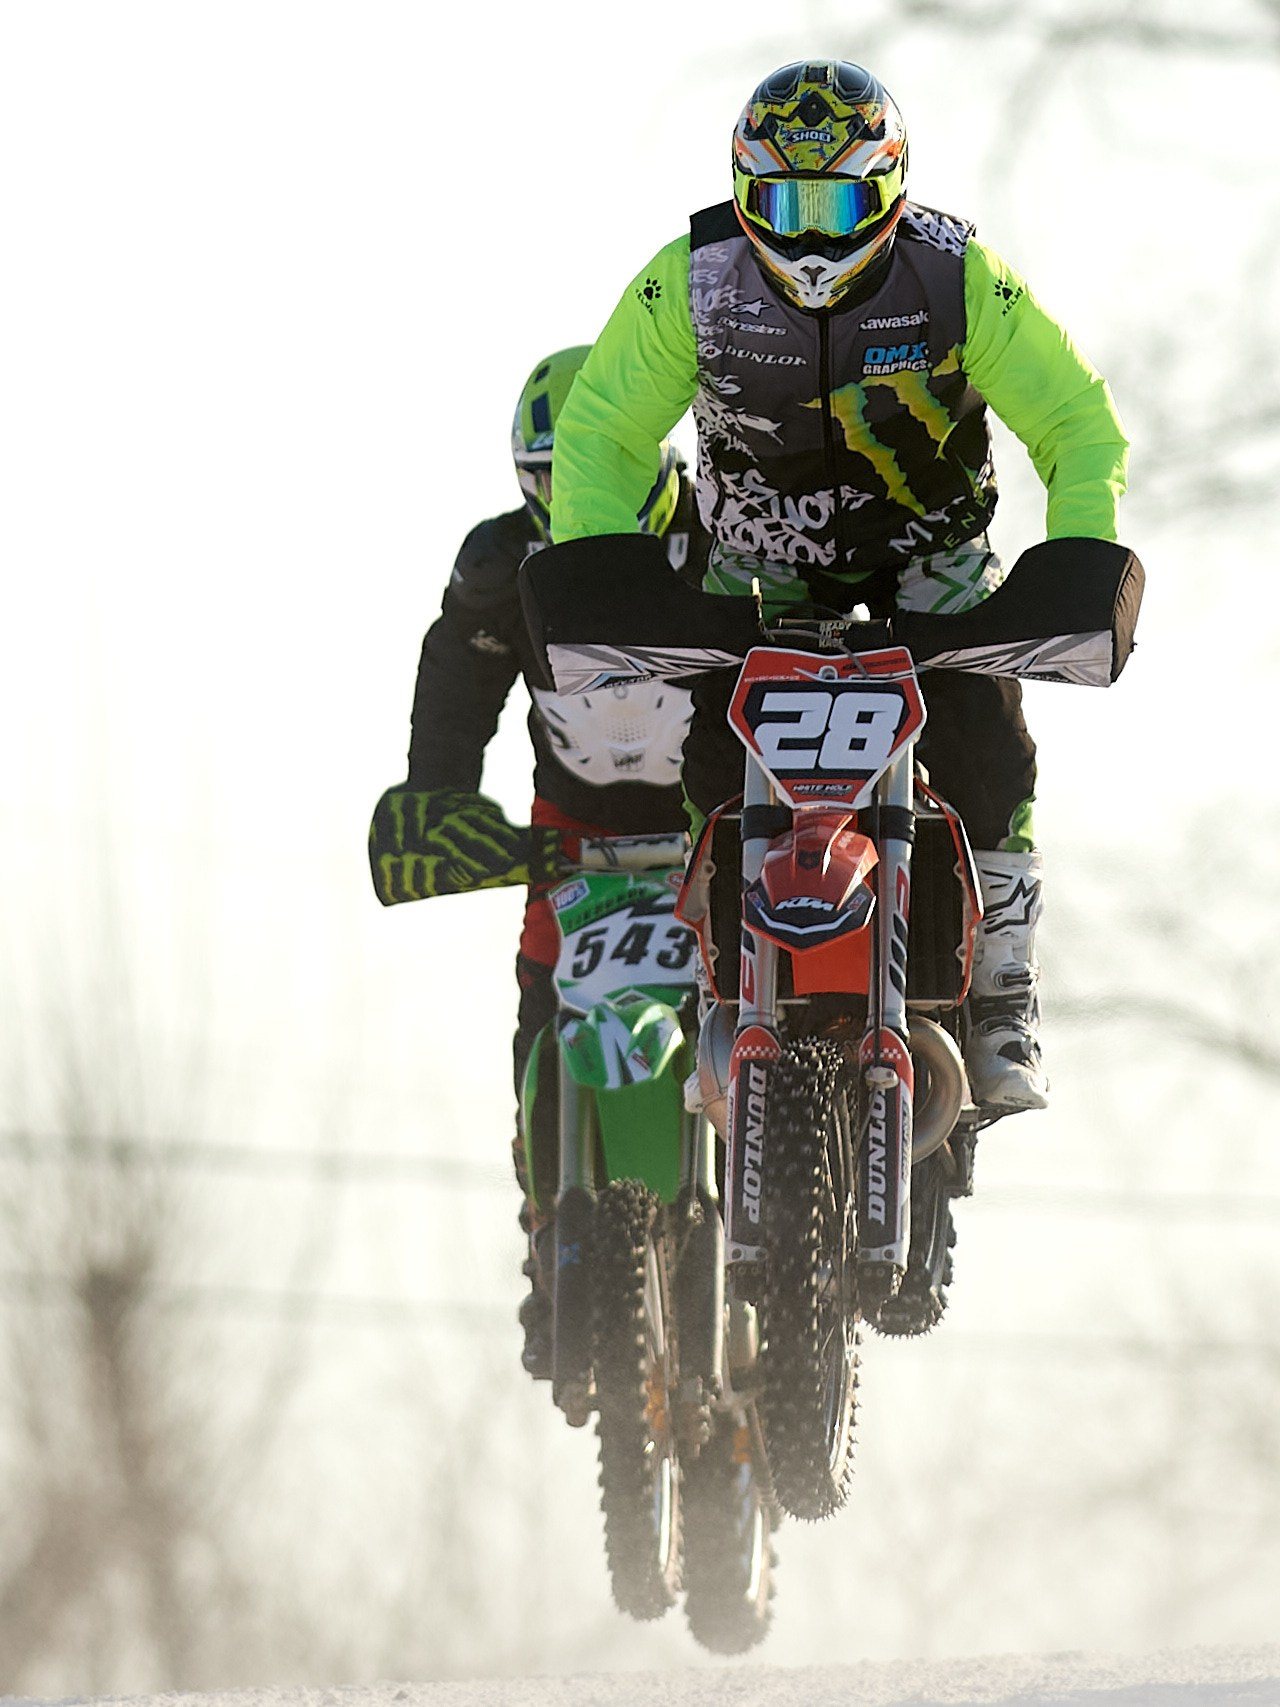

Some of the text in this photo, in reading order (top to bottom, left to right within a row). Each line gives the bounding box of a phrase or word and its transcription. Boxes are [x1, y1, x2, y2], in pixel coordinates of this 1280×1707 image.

[791, 130, 831, 143] SHOEI
[860, 310, 929, 329] awasak
[863, 360, 927, 375] GRAPHICS
[752, 692, 904, 770] 28
[775, 896, 835, 912] KTM
[572, 922, 698, 978] 543
[743, 1062, 767, 1224] DUNLOP
[868, 1088, 886, 1226] DUNLO
